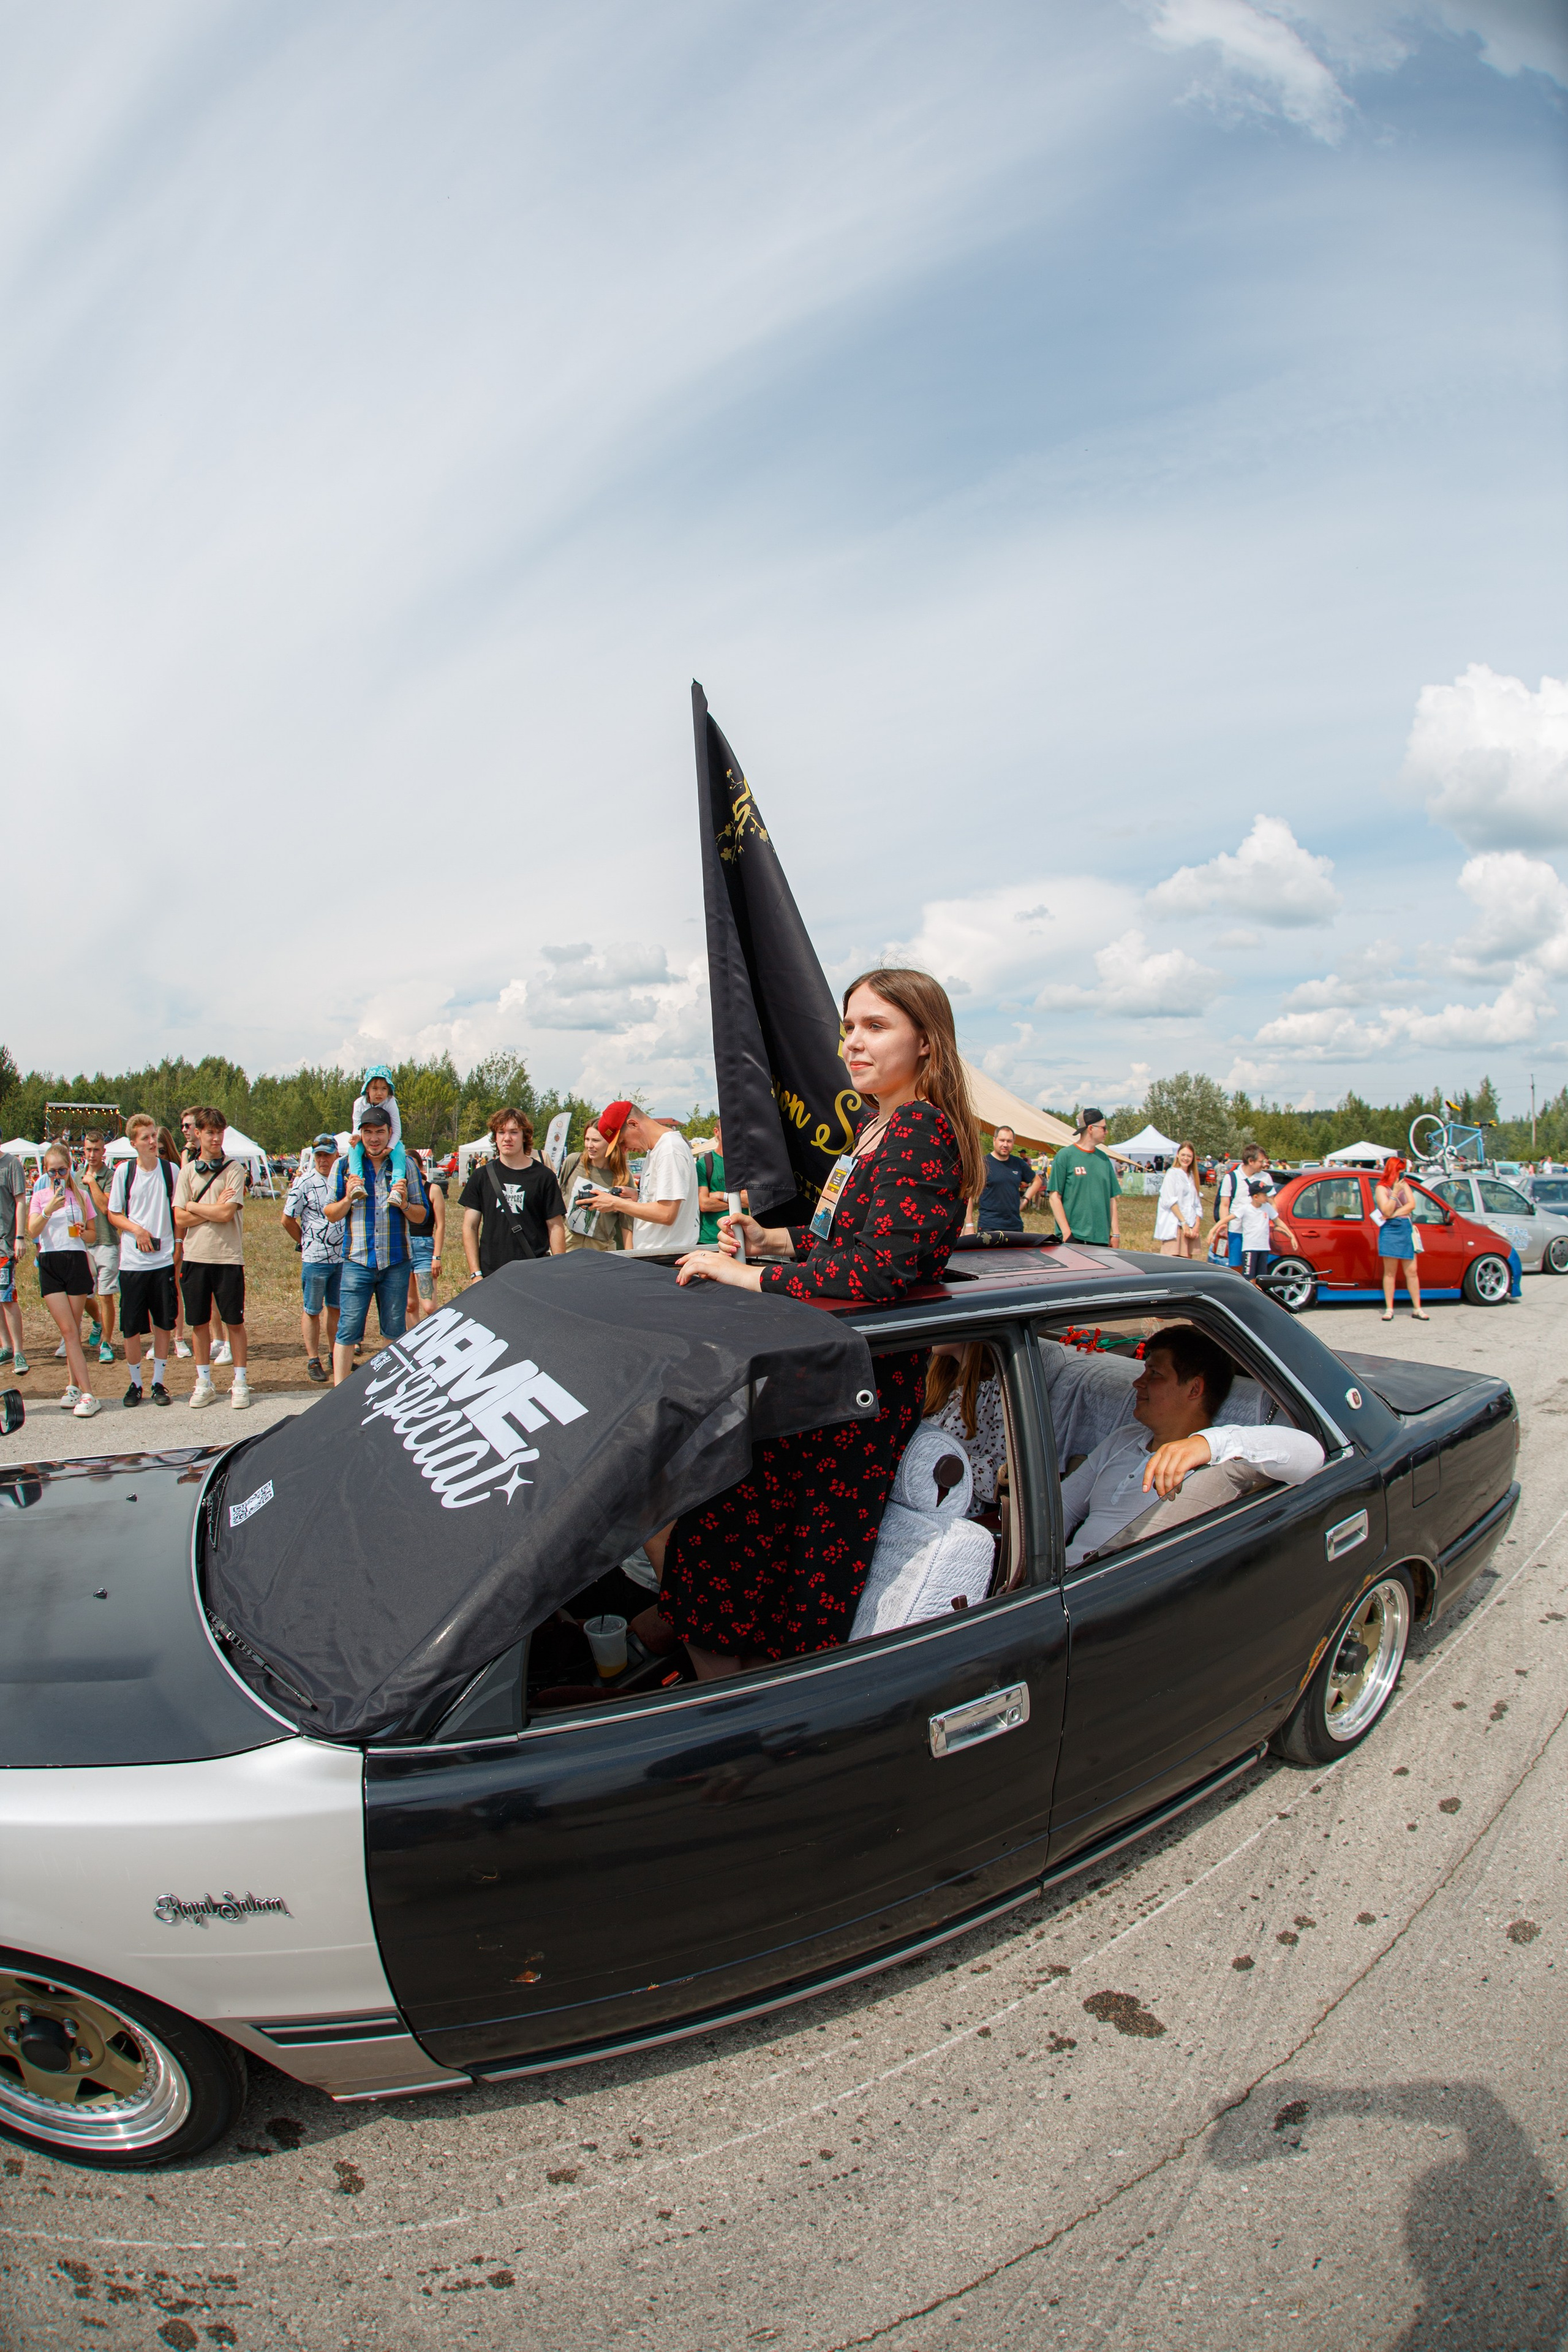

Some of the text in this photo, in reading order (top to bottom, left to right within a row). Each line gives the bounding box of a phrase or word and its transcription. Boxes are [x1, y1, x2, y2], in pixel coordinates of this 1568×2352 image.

[1074, 1166, 1087, 1176] 01
[505, 1194, 523, 1204] OPPERS
[396, 1308, 589, 1460] ONAME
[154, 1891, 290, 1926] Royal Saloon
